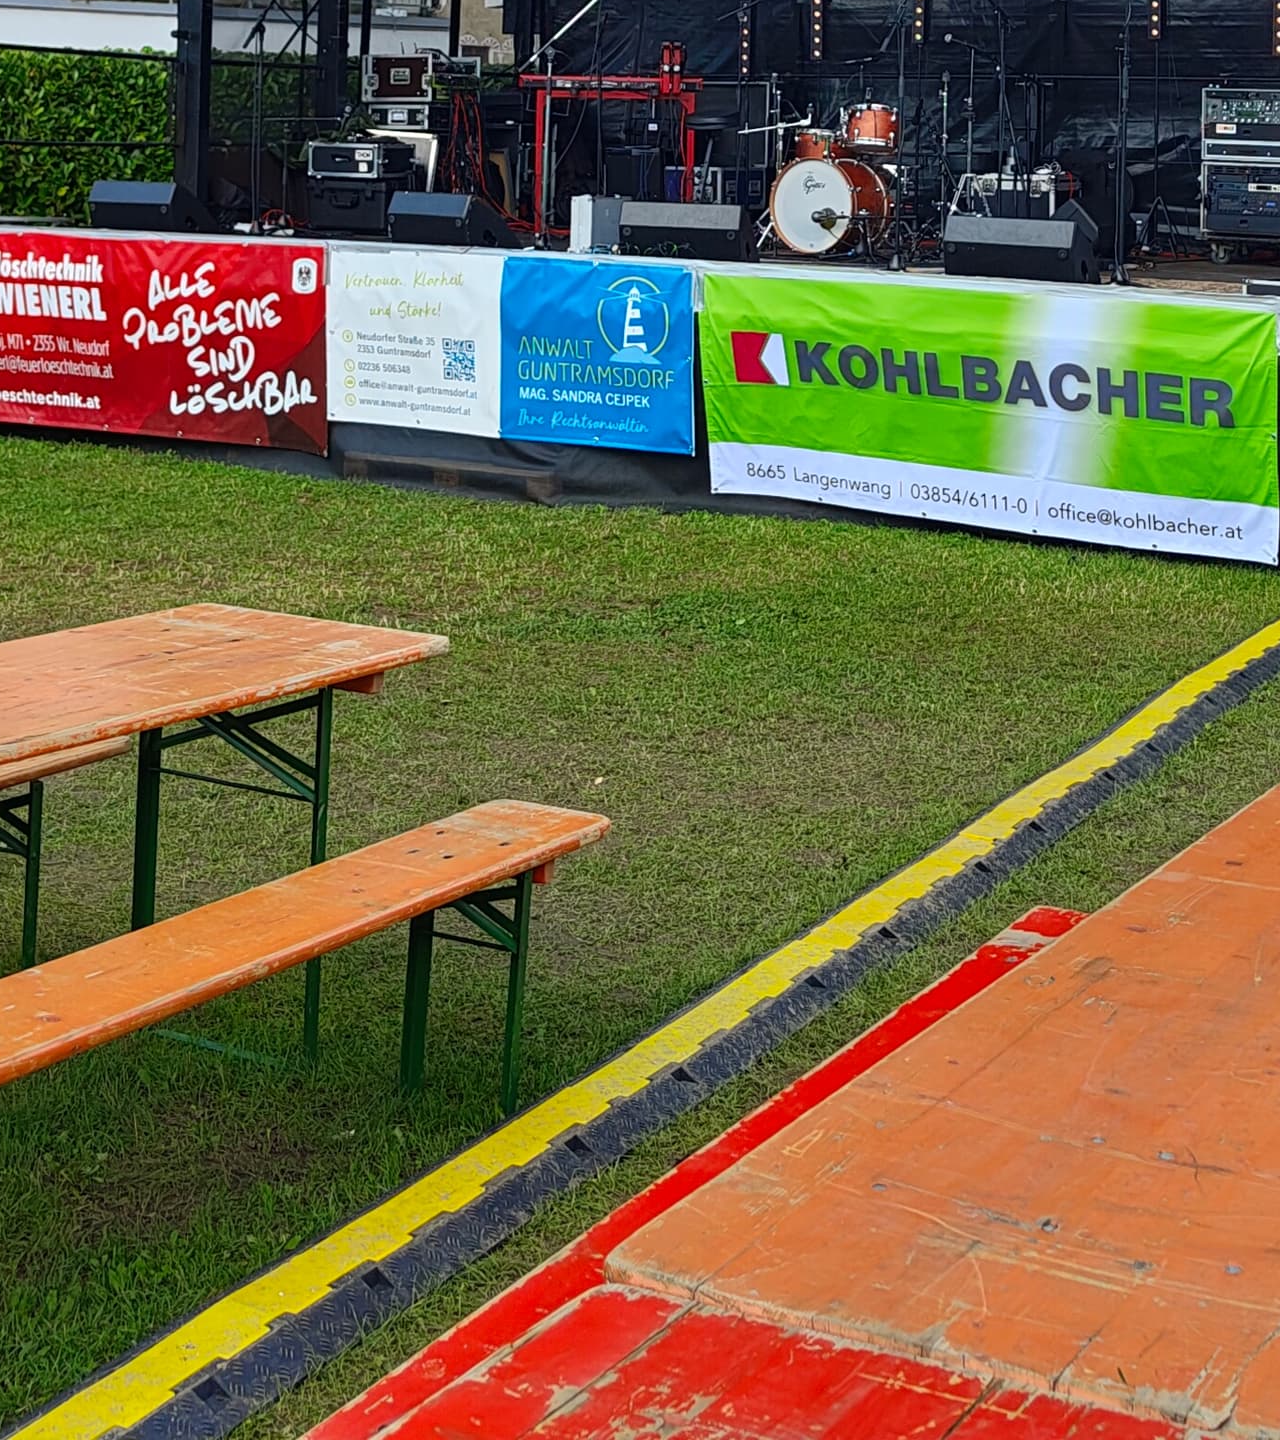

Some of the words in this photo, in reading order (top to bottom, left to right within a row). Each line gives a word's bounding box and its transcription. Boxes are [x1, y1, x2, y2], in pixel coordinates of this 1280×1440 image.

[147, 261, 216, 311] ALLE
[413, 269, 464, 289] Klarheit
[369, 301, 392, 319] und
[32, 334, 56, 352] 2355
[72, 338, 111, 357] Neudorf
[356, 331, 396, 343] Neudorfer
[398, 333, 423, 346] Straße
[425, 336, 436, 347] 35
[518, 335, 595, 360] ANWALT
[186, 335, 256, 383] SIND
[356, 343, 375, 355] 2353
[377, 345, 432, 359] Guntramsdorf
[518, 360, 676, 390] GUNTRAMSDORF
[793, 338, 1236, 429] KOHLBACHER
[169, 370, 318, 416] LÖSCHBAR
[519, 386, 549, 401] MAG.
[552, 389, 603, 405] SANDRA
[605, 392, 650, 408] CEJPEK
[358, 397, 471, 417] www.anwalt-guntramsdorf.at
[517, 408, 545, 426] Ihre
[746, 462, 786, 481] 8665
[793, 466, 891, 500] Langenwang
[910, 481, 1028, 515] 03854/6111-0
[1047, 502, 1244, 541] office@kohlbacher.at
